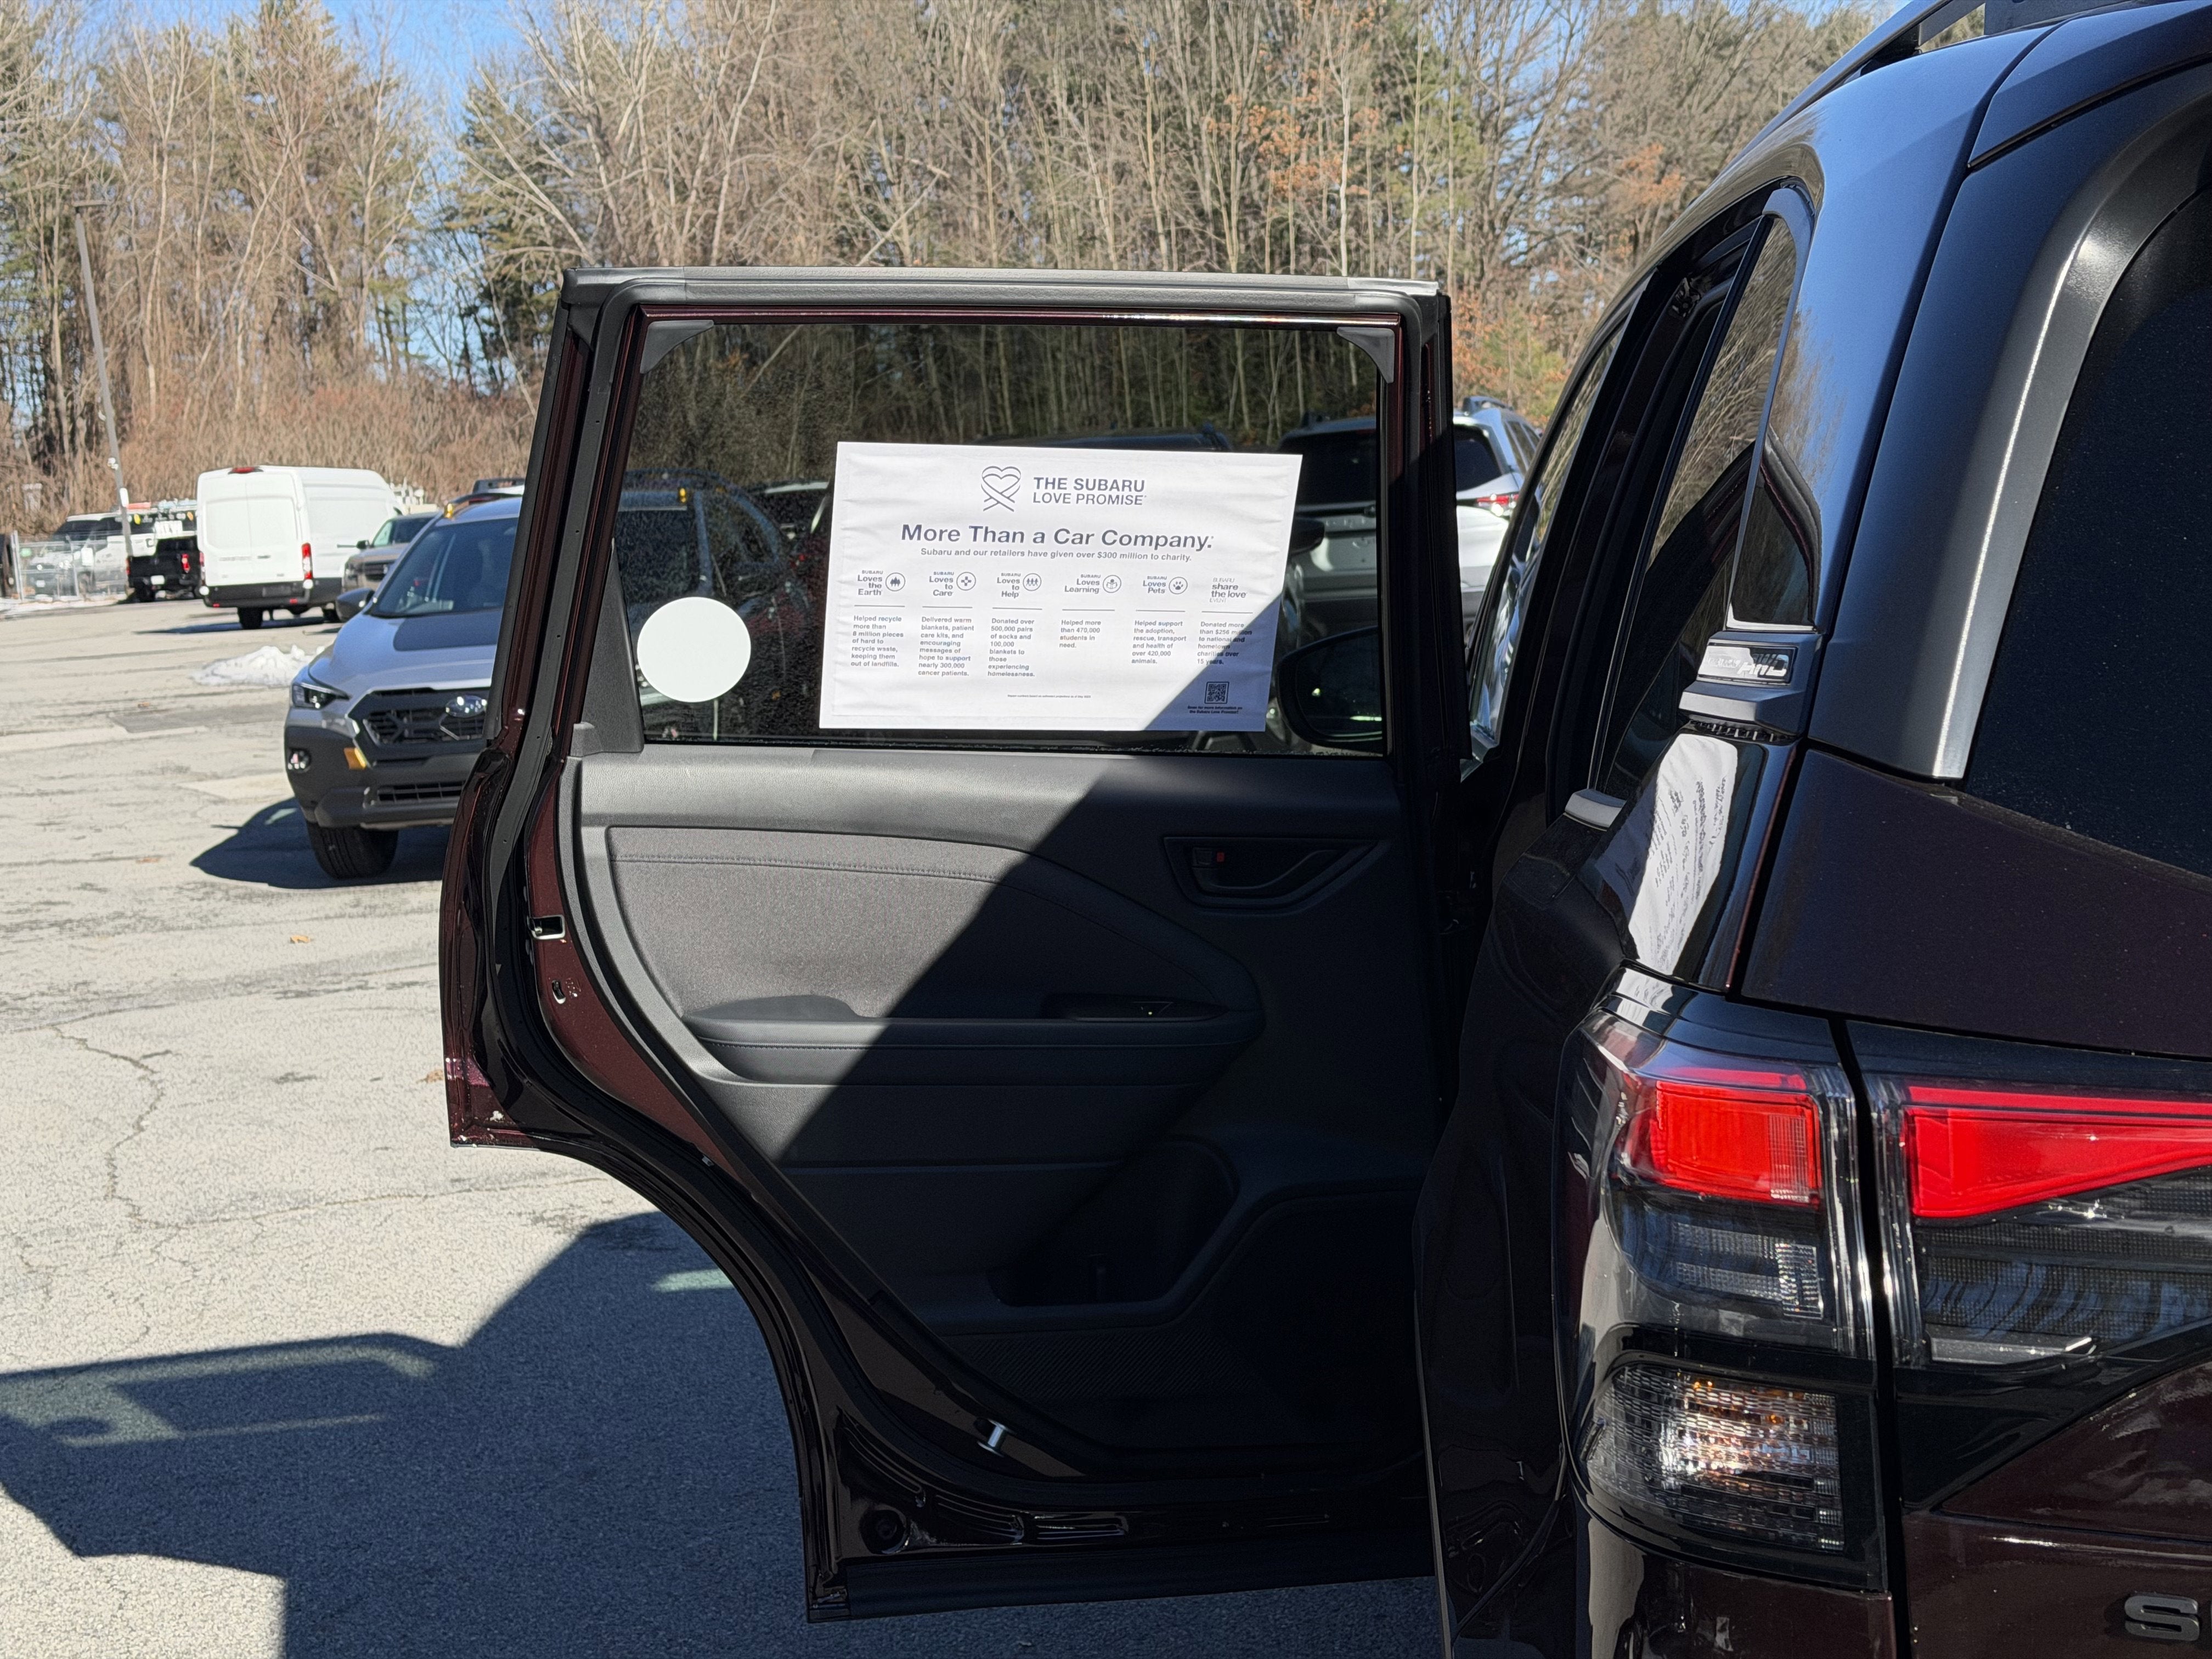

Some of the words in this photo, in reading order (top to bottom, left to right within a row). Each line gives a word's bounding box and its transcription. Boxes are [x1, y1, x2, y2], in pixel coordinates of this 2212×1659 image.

[1034, 477, 1067, 490] THE
[1074, 478, 1144, 492] SUBARU
[1033, 492, 1071, 504] LOVE
[1076, 494, 1143, 505] PROMISE
[902, 524, 960, 541] More
[969, 526, 1024, 543] Than
[1033, 532, 1045, 543] a
[1054, 528, 1094, 544] Car
[1102, 530, 1212, 551] Company.
[1051, 550, 1073, 558] given
[1161, 554, 1191, 562] charity.
[1065, 585, 1099, 594] Learning
[2124, 1594, 2212, 1641] S
